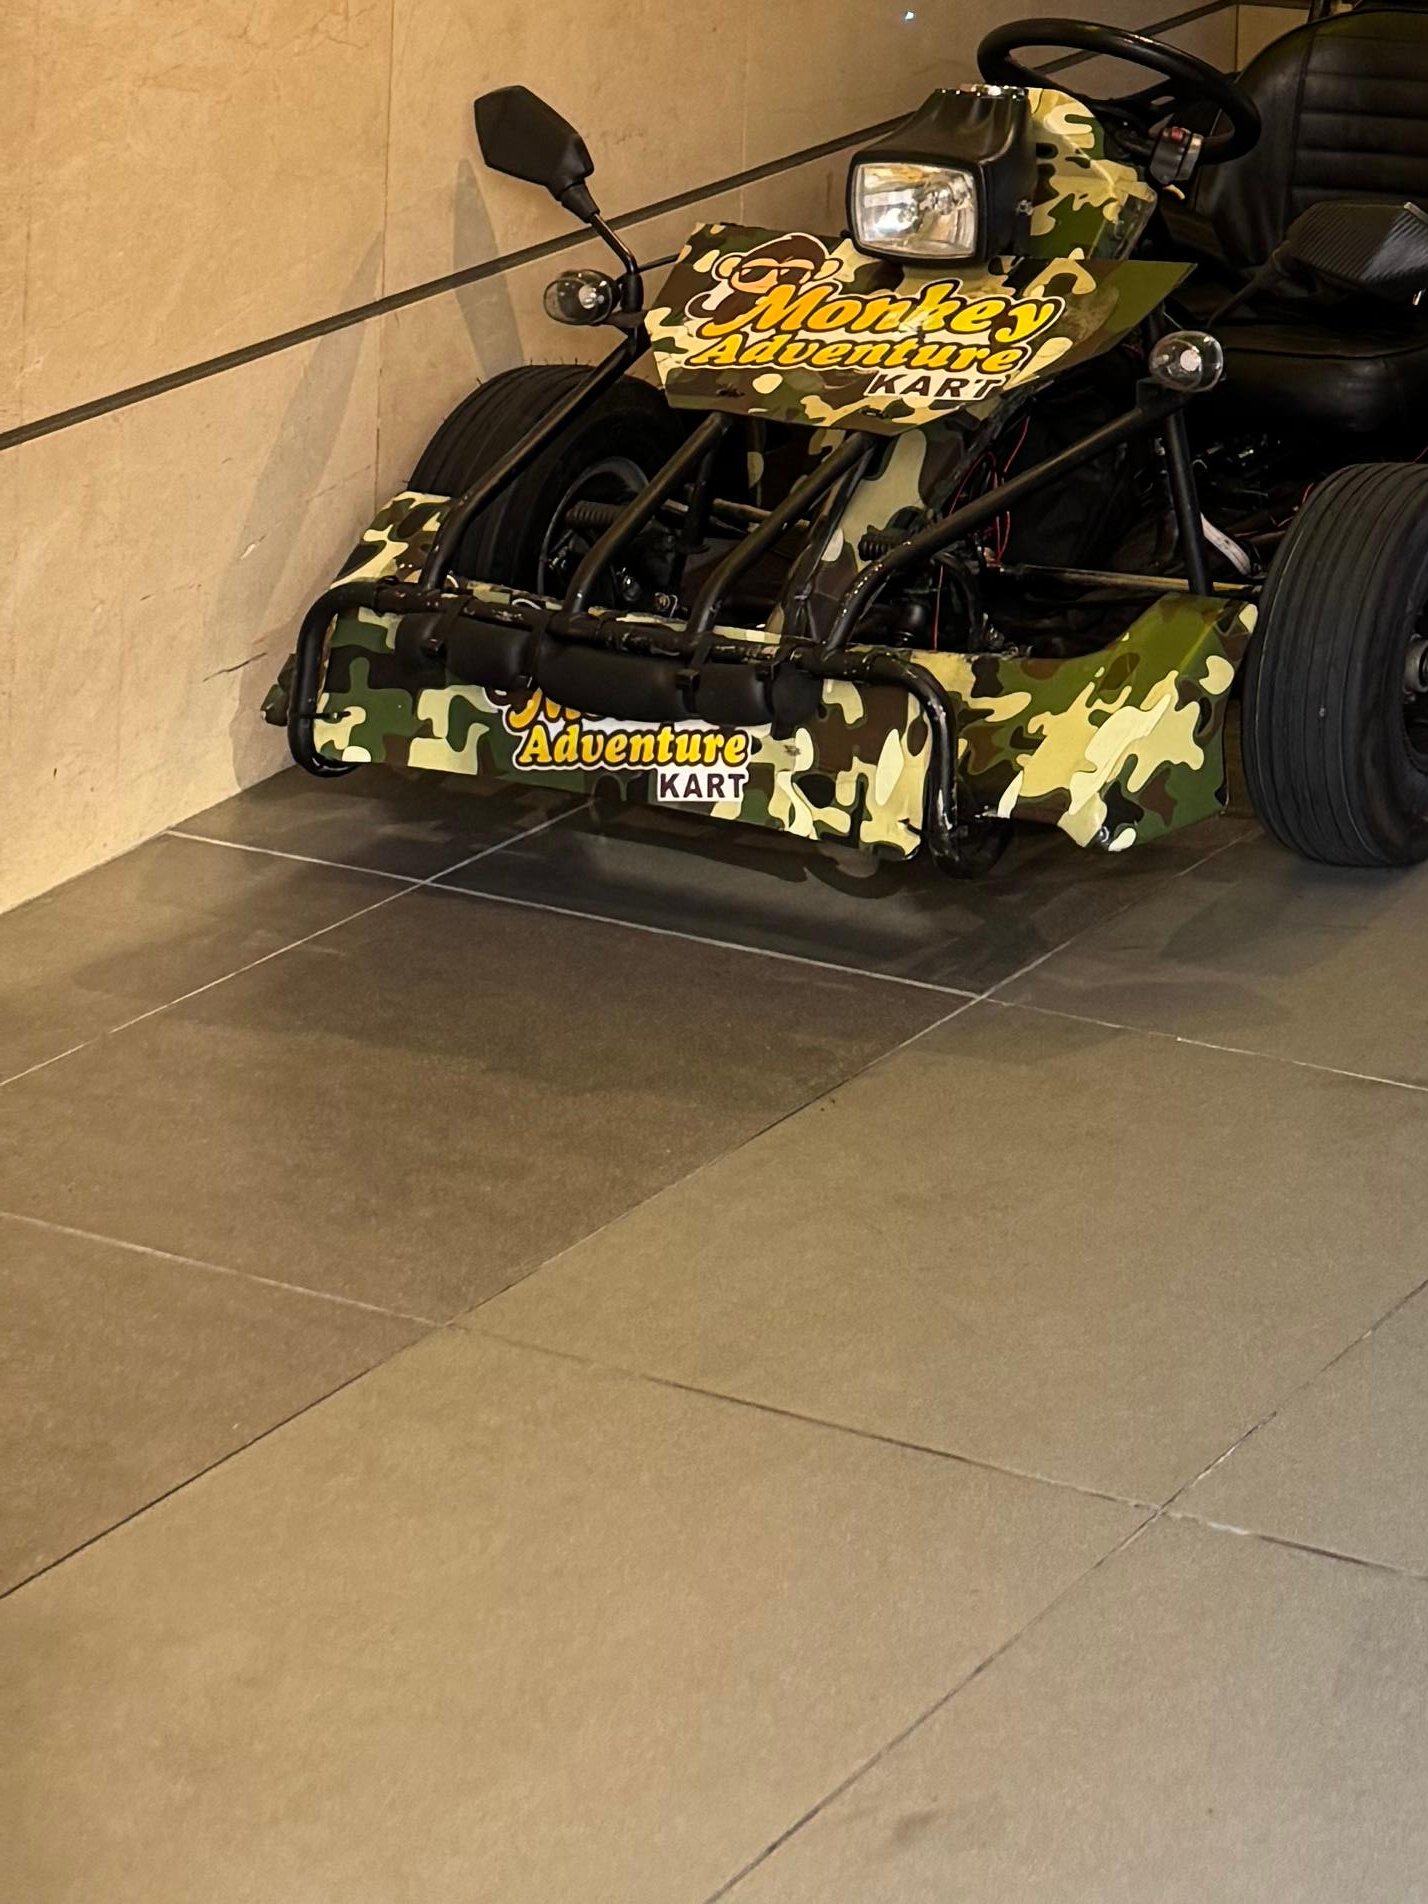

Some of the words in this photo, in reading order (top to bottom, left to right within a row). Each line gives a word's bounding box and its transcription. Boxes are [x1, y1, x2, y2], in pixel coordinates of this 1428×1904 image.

[698, 278, 1061, 344] Monkey
[686, 331, 1024, 374] Adventure
[866, 373, 1005, 399] KART
[515, 722, 749, 769] Adventure
[659, 772, 746, 799] KART
